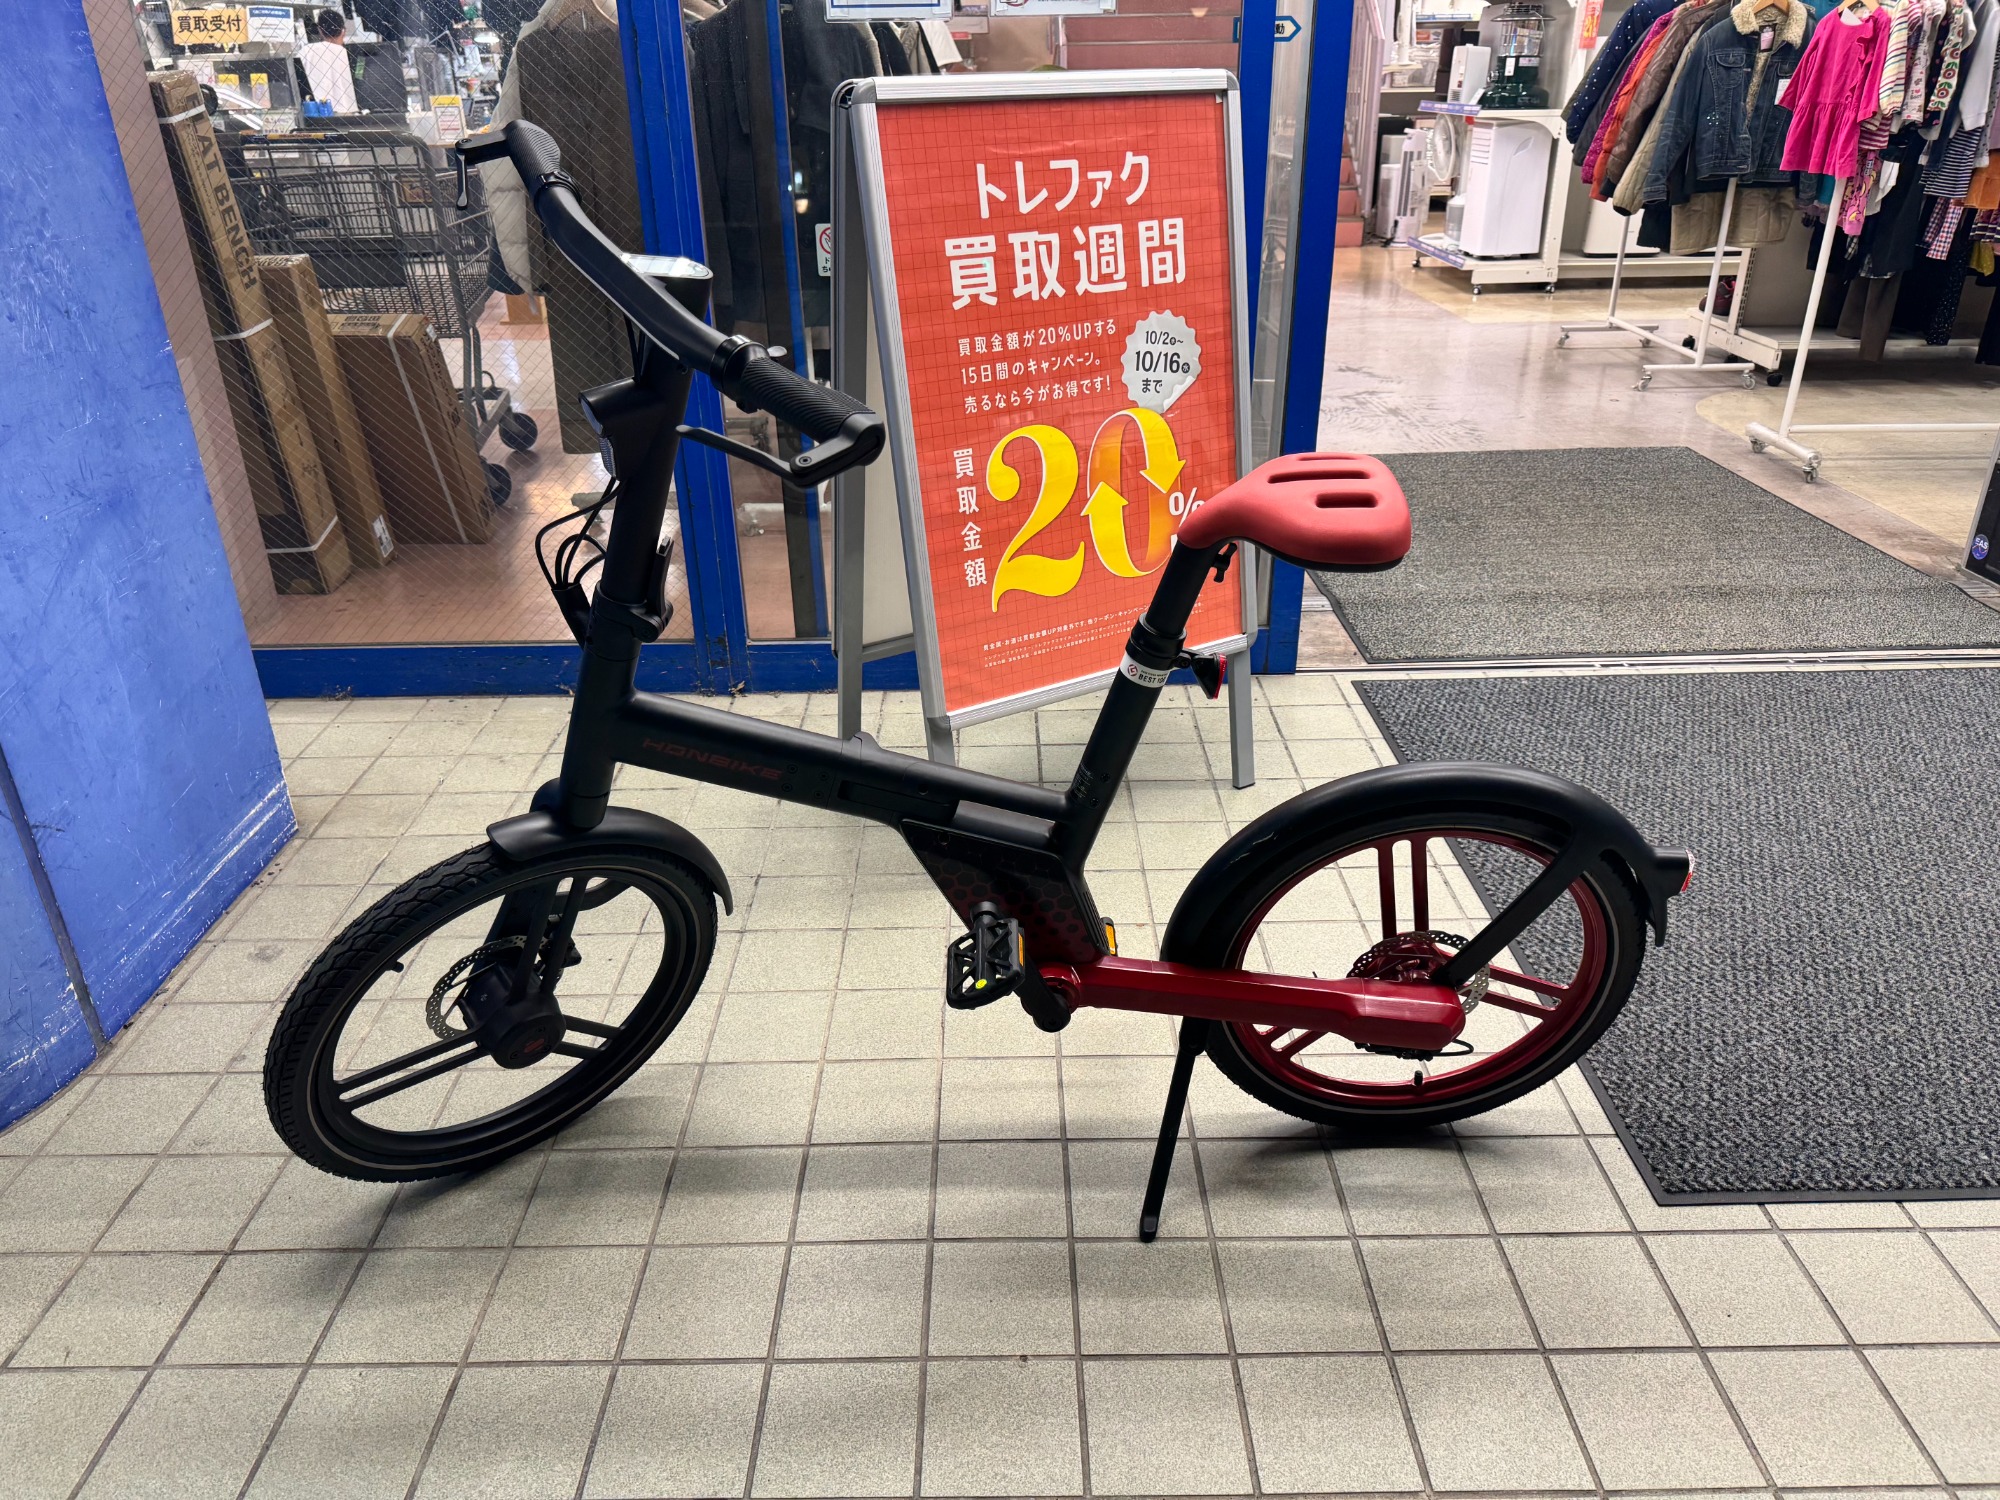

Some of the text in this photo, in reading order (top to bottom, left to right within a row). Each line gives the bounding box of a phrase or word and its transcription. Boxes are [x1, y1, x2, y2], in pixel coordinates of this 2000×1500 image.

[177, 15, 242, 33] 買取受付
[976, 151, 1149, 219] トレファク
[213, 182, 258, 291] BENCH
[944, 217, 1186, 310] 買取週間
[958, 319, 1116, 357] 買取金額が20%UPする
[961, 352, 1101, 385] 15日間のキャンペーン。
[1141, 377, 1163, 394] まで
[964, 375, 1111, 415] 売るなら今がお得です!
[953, 447, 988, 588] 買取金額
[1138, 673, 1156, 684] BEST
[643, 739, 783, 779] HONBIKE
